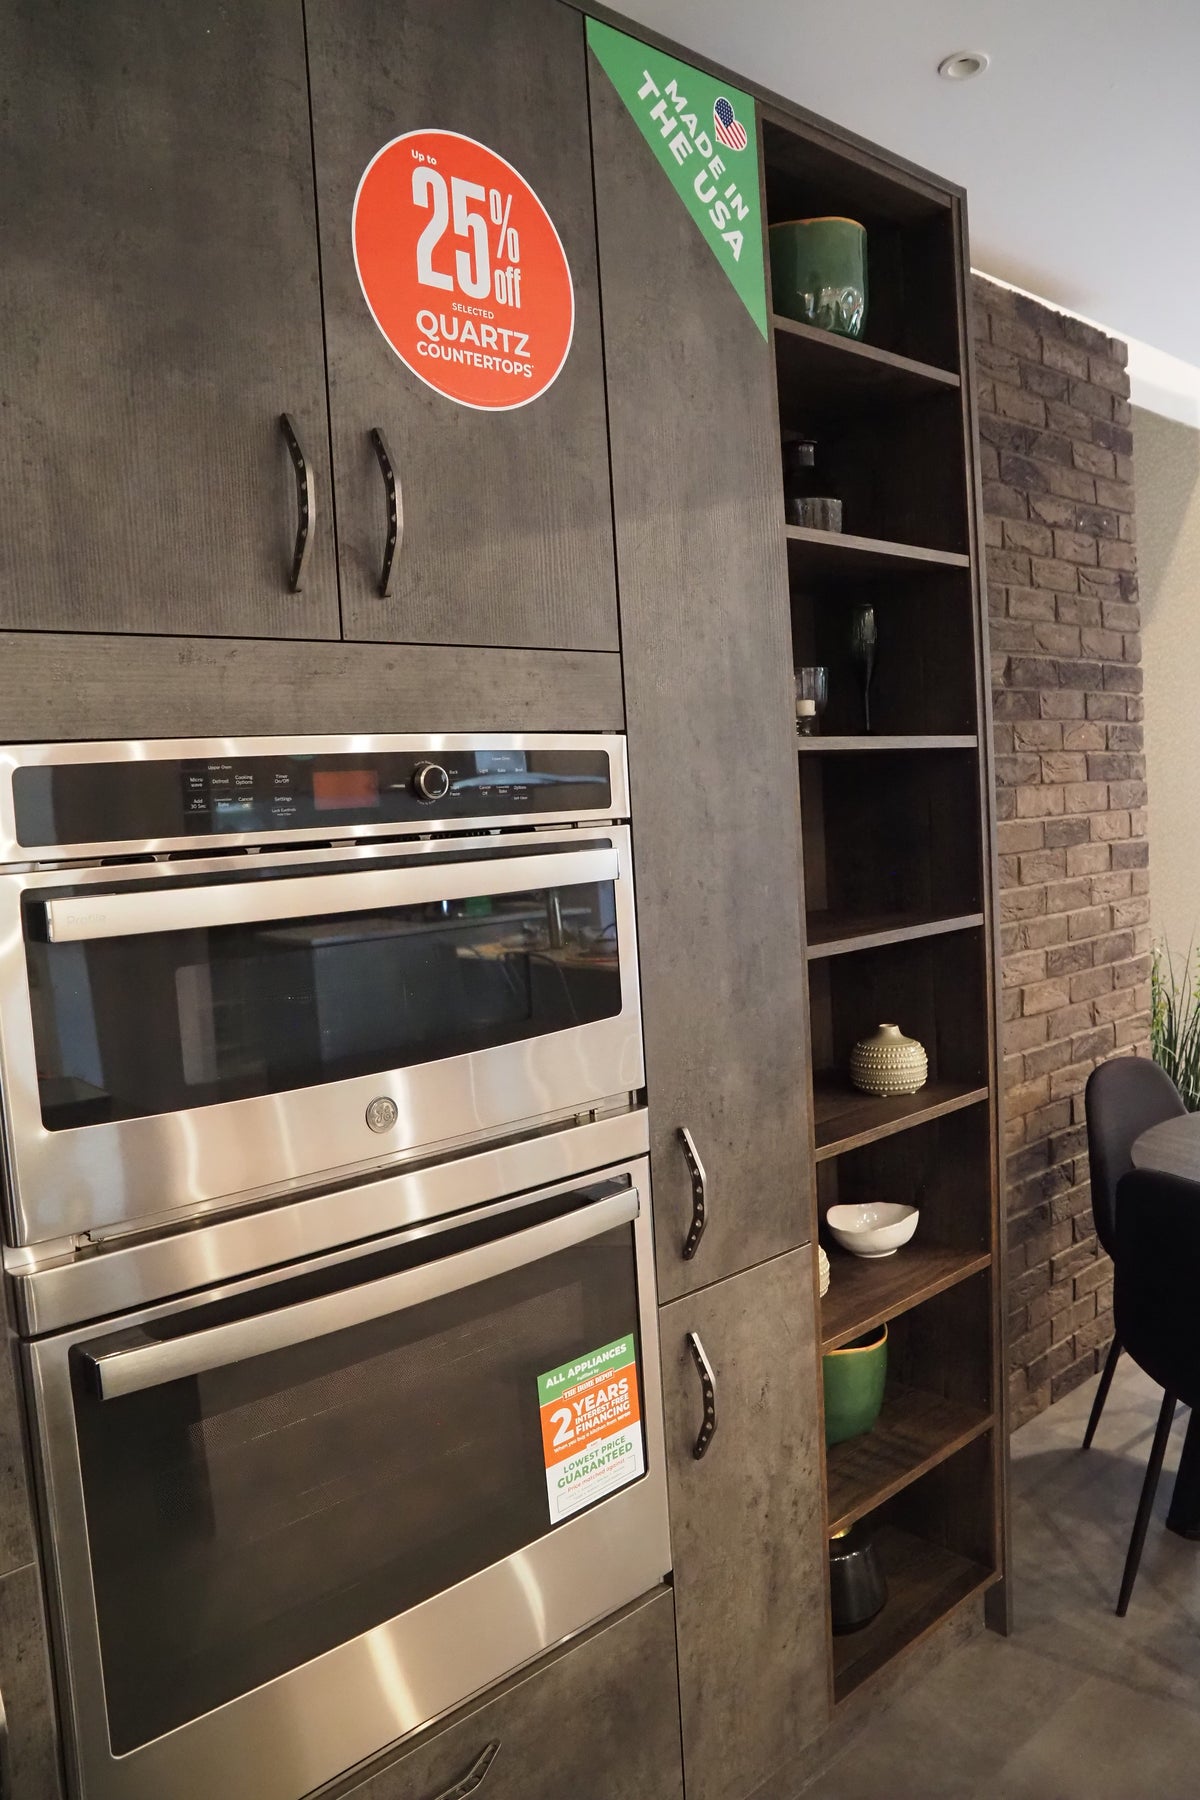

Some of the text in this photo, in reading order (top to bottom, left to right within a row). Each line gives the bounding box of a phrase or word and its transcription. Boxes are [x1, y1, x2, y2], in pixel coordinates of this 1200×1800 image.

[411, 149, 437, 165] Up to
[637, 70, 744, 262] THE USA
[665, 79, 749, 221] MADE IN
[412, 166, 521, 308] 25% off
[451, 302, 494, 320] SELECTED
[416, 310, 531, 358] QUARTZ
[546, 1343, 627, 1389] ALL APPLIANCES
[550, 1377, 629, 1446] 2 YEARS
[564, 1388, 577, 1399] THE
[575, 1402, 610, 1425] INTEREST
[611, 1393, 630, 1407] FREE
[576, 1401, 630, 1435] FINANCING
[557, 1442, 633, 1489] GUARANTEED
[564, 1435, 626, 1474] LOWEST PRICE
[568, 1482, 581, 1493] Price
[581, 1468, 606, 1485] matched
